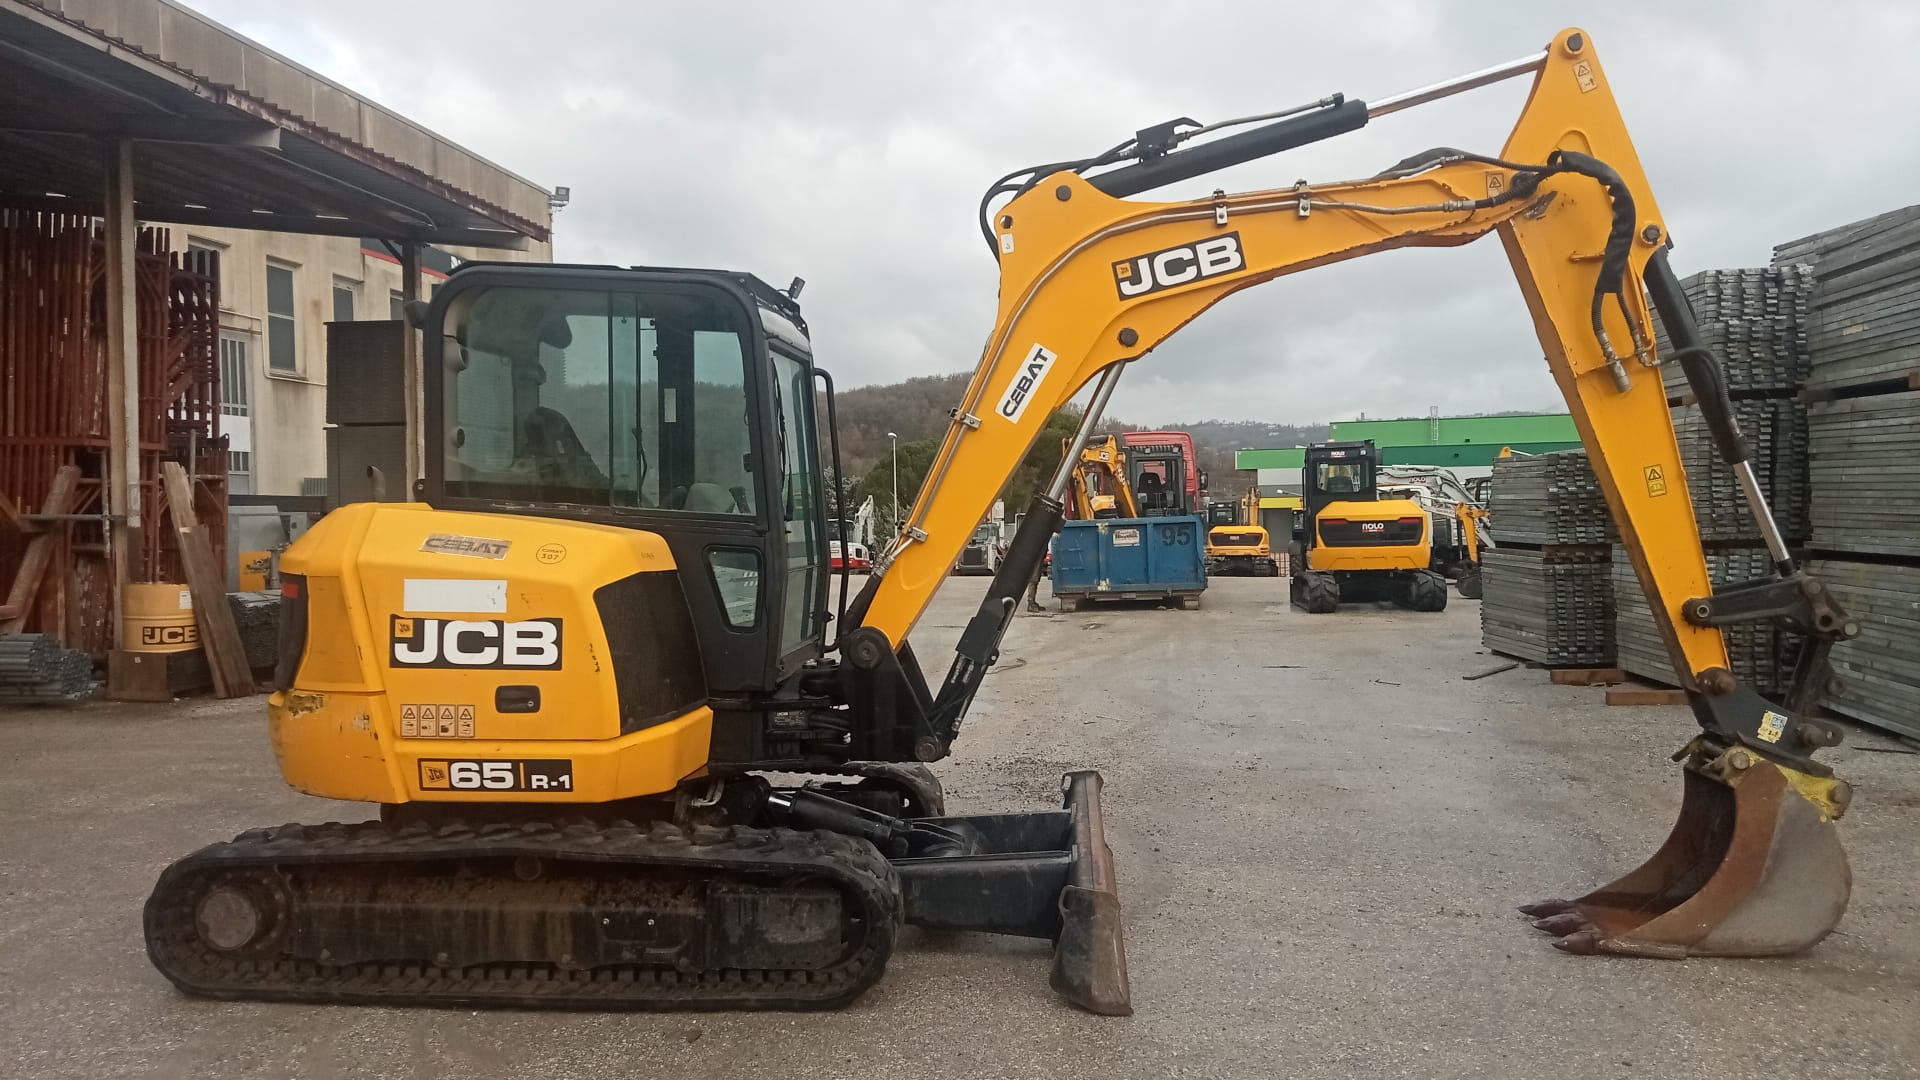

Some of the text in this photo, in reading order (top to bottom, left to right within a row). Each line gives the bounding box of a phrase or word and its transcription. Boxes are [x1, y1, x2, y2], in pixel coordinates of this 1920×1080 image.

[1119, 236, 1242, 296] JCB
[1002, 347, 1049, 418] CEBAT
[1161, 525, 1191, 546] 95
[394, 619, 559, 666] JCB
[450, 761, 571, 789] 65 R-1
